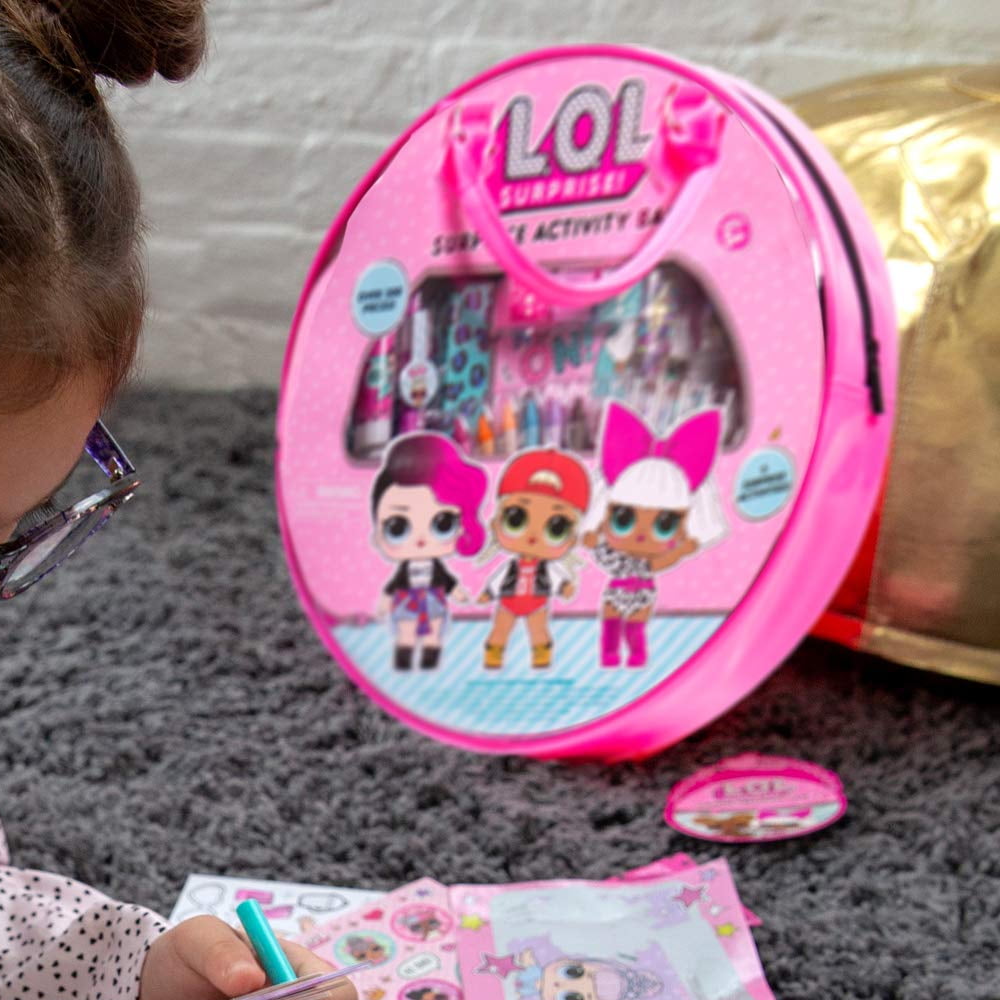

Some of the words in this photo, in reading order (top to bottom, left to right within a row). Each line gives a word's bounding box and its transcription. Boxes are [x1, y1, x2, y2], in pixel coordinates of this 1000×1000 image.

[499, 170, 627, 207] SURPRISE!
[532, 212, 631, 242] ACTIVITY
[636, 208, 669, 231] BA
